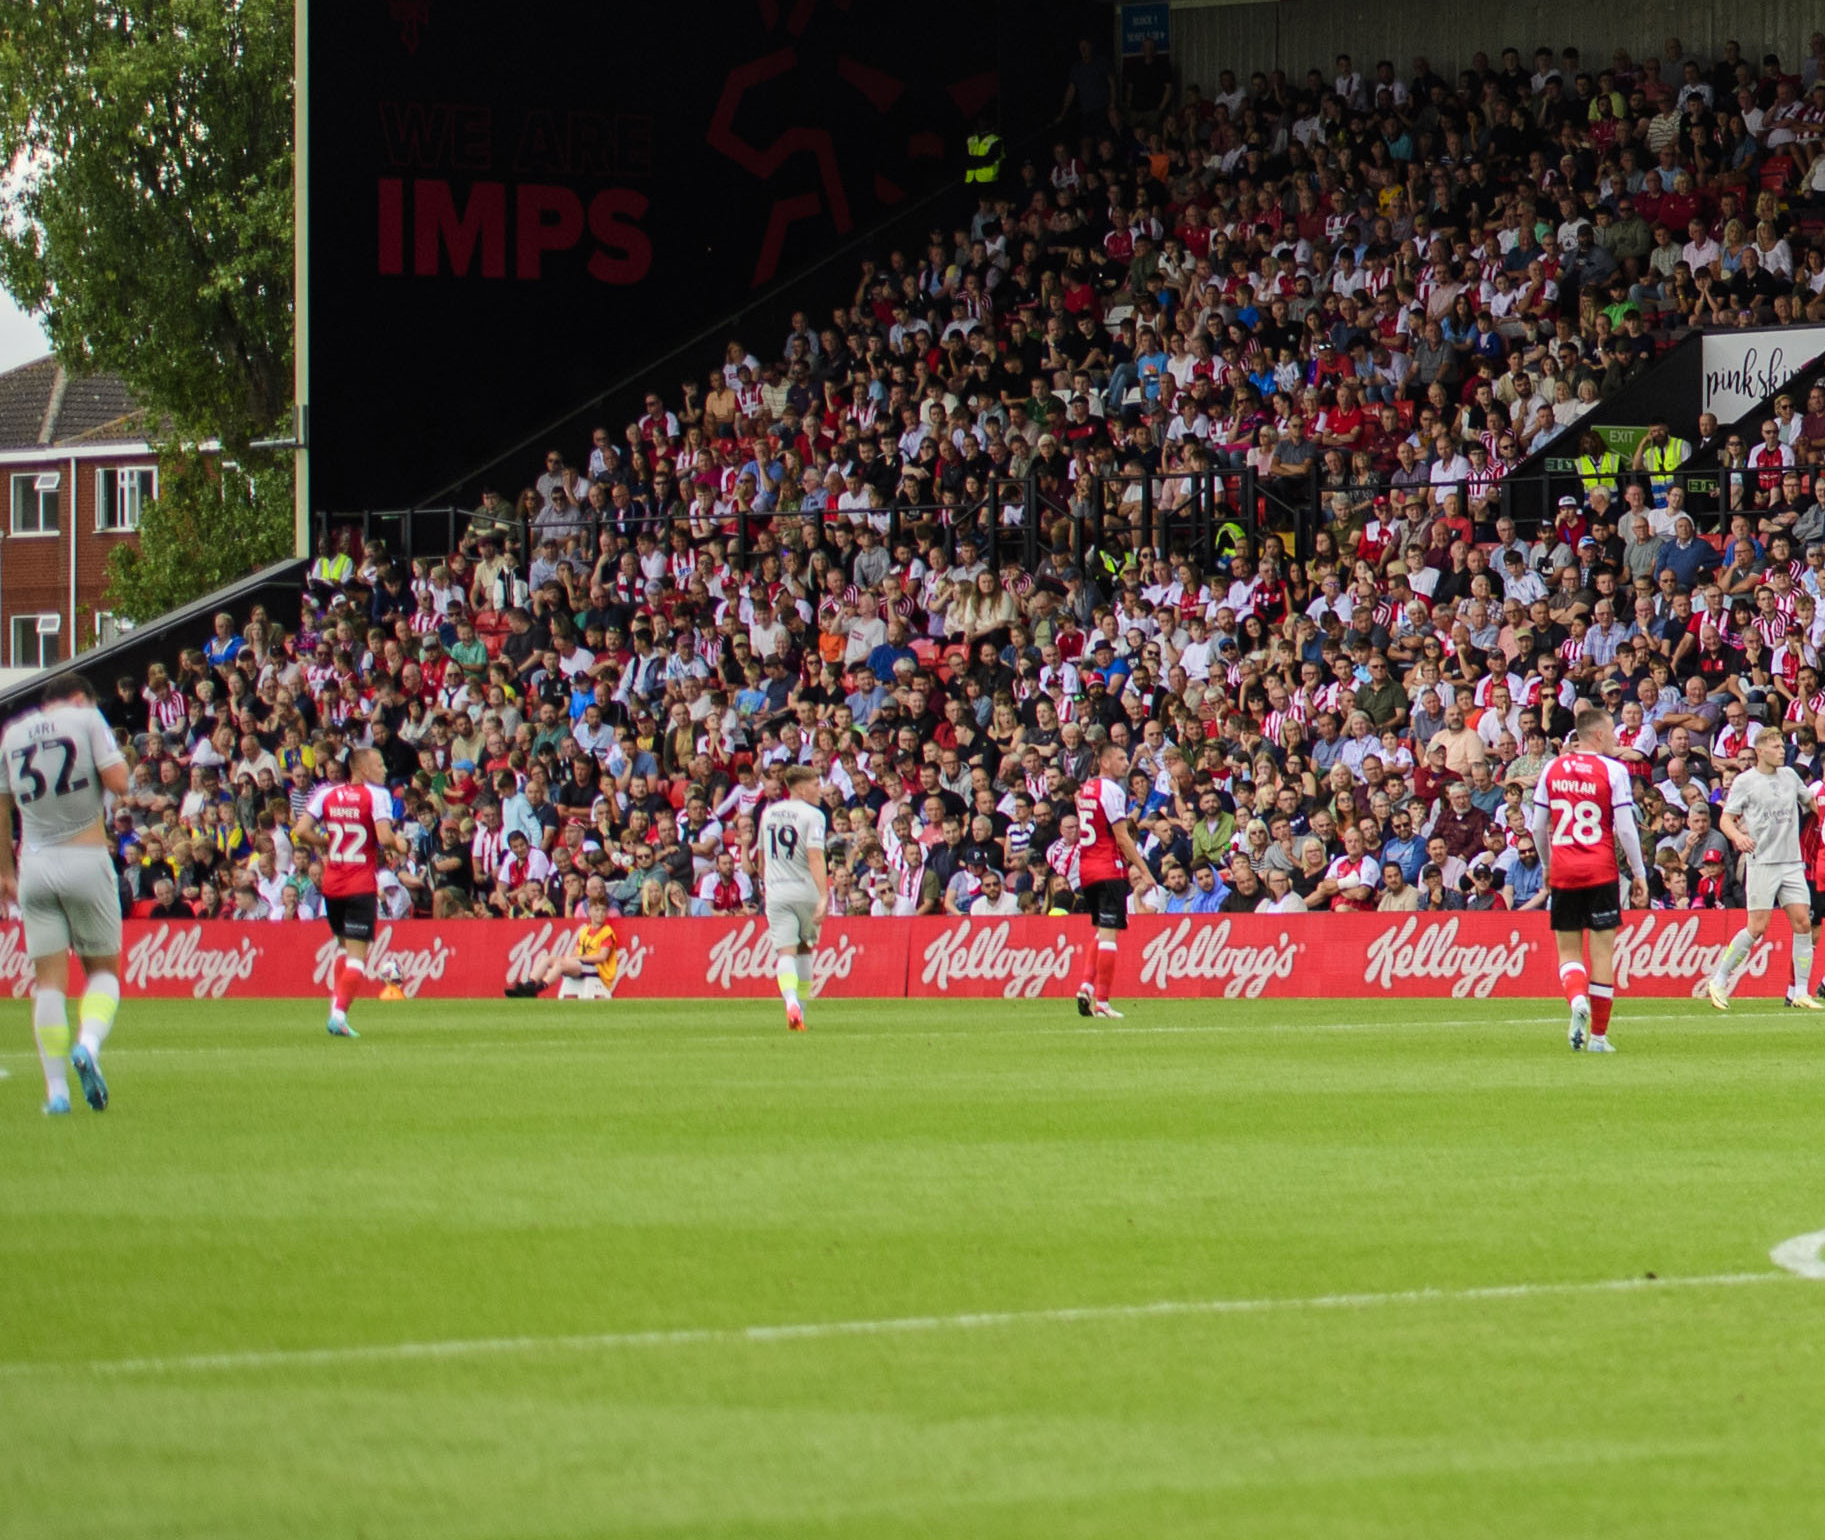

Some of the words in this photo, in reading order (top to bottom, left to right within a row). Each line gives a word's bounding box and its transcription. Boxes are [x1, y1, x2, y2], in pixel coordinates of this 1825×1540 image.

[377, 177, 654, 286] IMPS
[1706, 347, 1801, 409] pinkski
[1610, 430, 1635, 443] EXIT
[11, 736, 89, 805] 32
[1551, 779, 1597, 795] MOYLAN
[327, 822, 368, 863] 22
[767, 823, 799, 860] 19
[1550, 798, 1603, 846] 28
[125, 923, 257, 998] Kellogg's
[313, 925, 448, 998] Klogg's
[509, 922, 647, 992] Kll's
[706, 919, 857, 997] Kellg's
[921, 919, 1075, 998] Kellogg's
[1140, 917, 1298, 998] Kellogg's
[1364, 915, 1529, 998] Kellogg's
[1612, 914, 1774, 998] Kellogs
